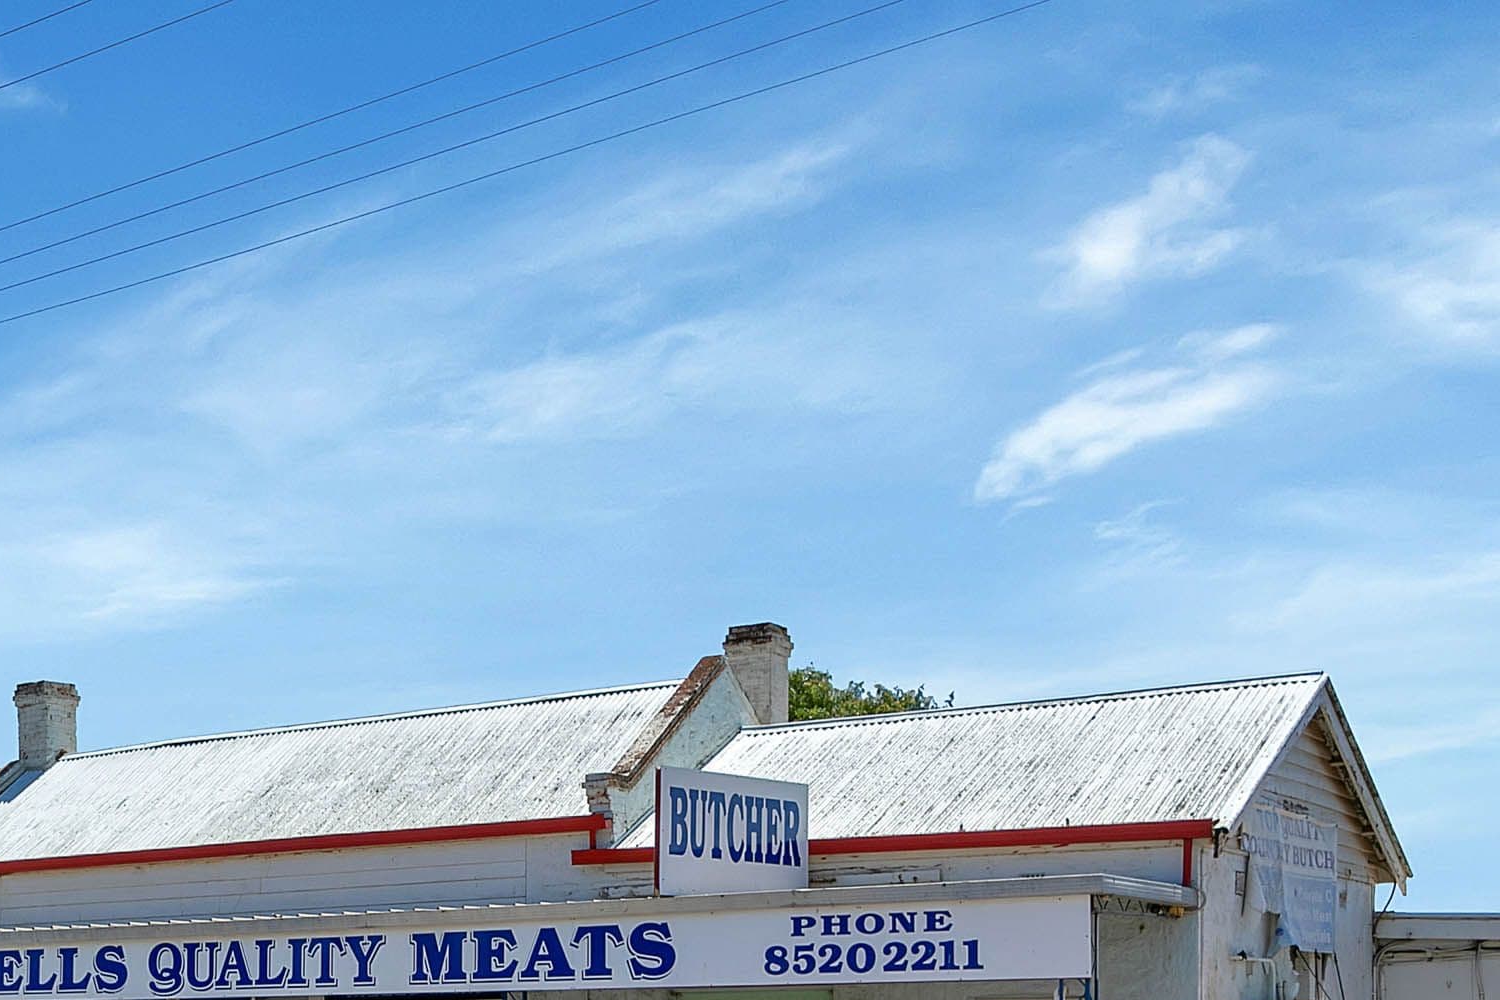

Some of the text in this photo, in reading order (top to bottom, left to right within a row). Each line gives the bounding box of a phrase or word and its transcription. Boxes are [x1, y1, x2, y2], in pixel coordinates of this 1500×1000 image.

[668, 786, 802, 867] BUTCHER
[147, 934, 387, 996] QUALITY
[409, 921, 678, 986] MEATS
[790, 909, 955, 937] PHONE
